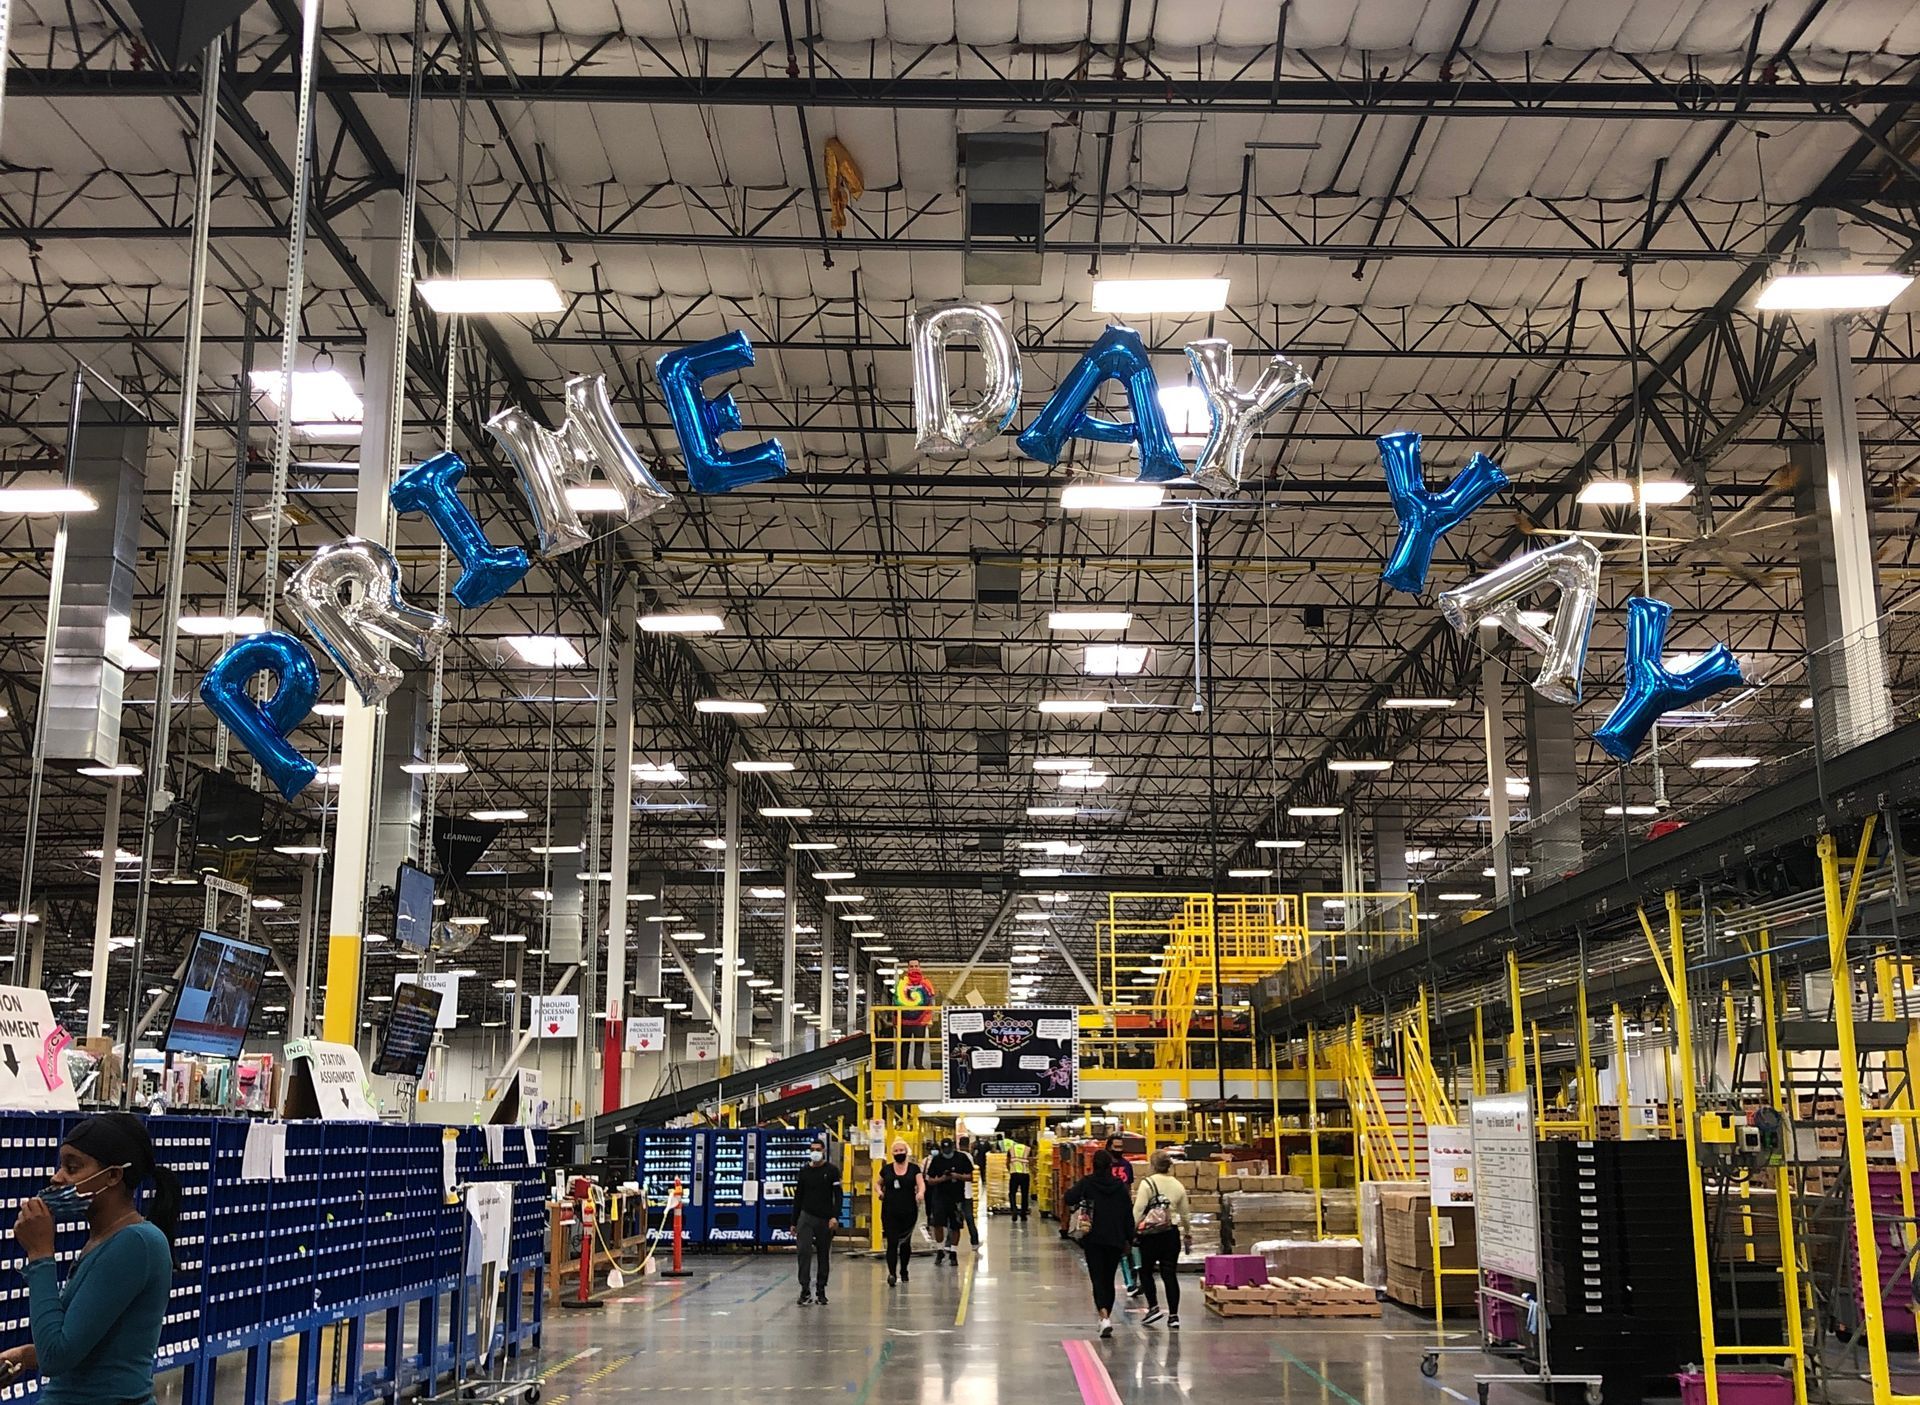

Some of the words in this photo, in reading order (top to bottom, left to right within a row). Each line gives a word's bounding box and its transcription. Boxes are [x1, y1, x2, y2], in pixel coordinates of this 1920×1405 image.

[200, 329, 788, 800] PRIME
[909, 301, 1313, 495] DAY
[1376, 431, 1743, 762] YAY
[442, 832, 482, 843] LEARNING
[206, 875, 223, 889] HUMAN
[223, 880, 247, 896] RESOURCES
[320, 1053, 347, 1066] STATION
[320, 1071, 357, 1084] ASSIGNMENT
[646, 1228, 691, 1240] FASTEAL
